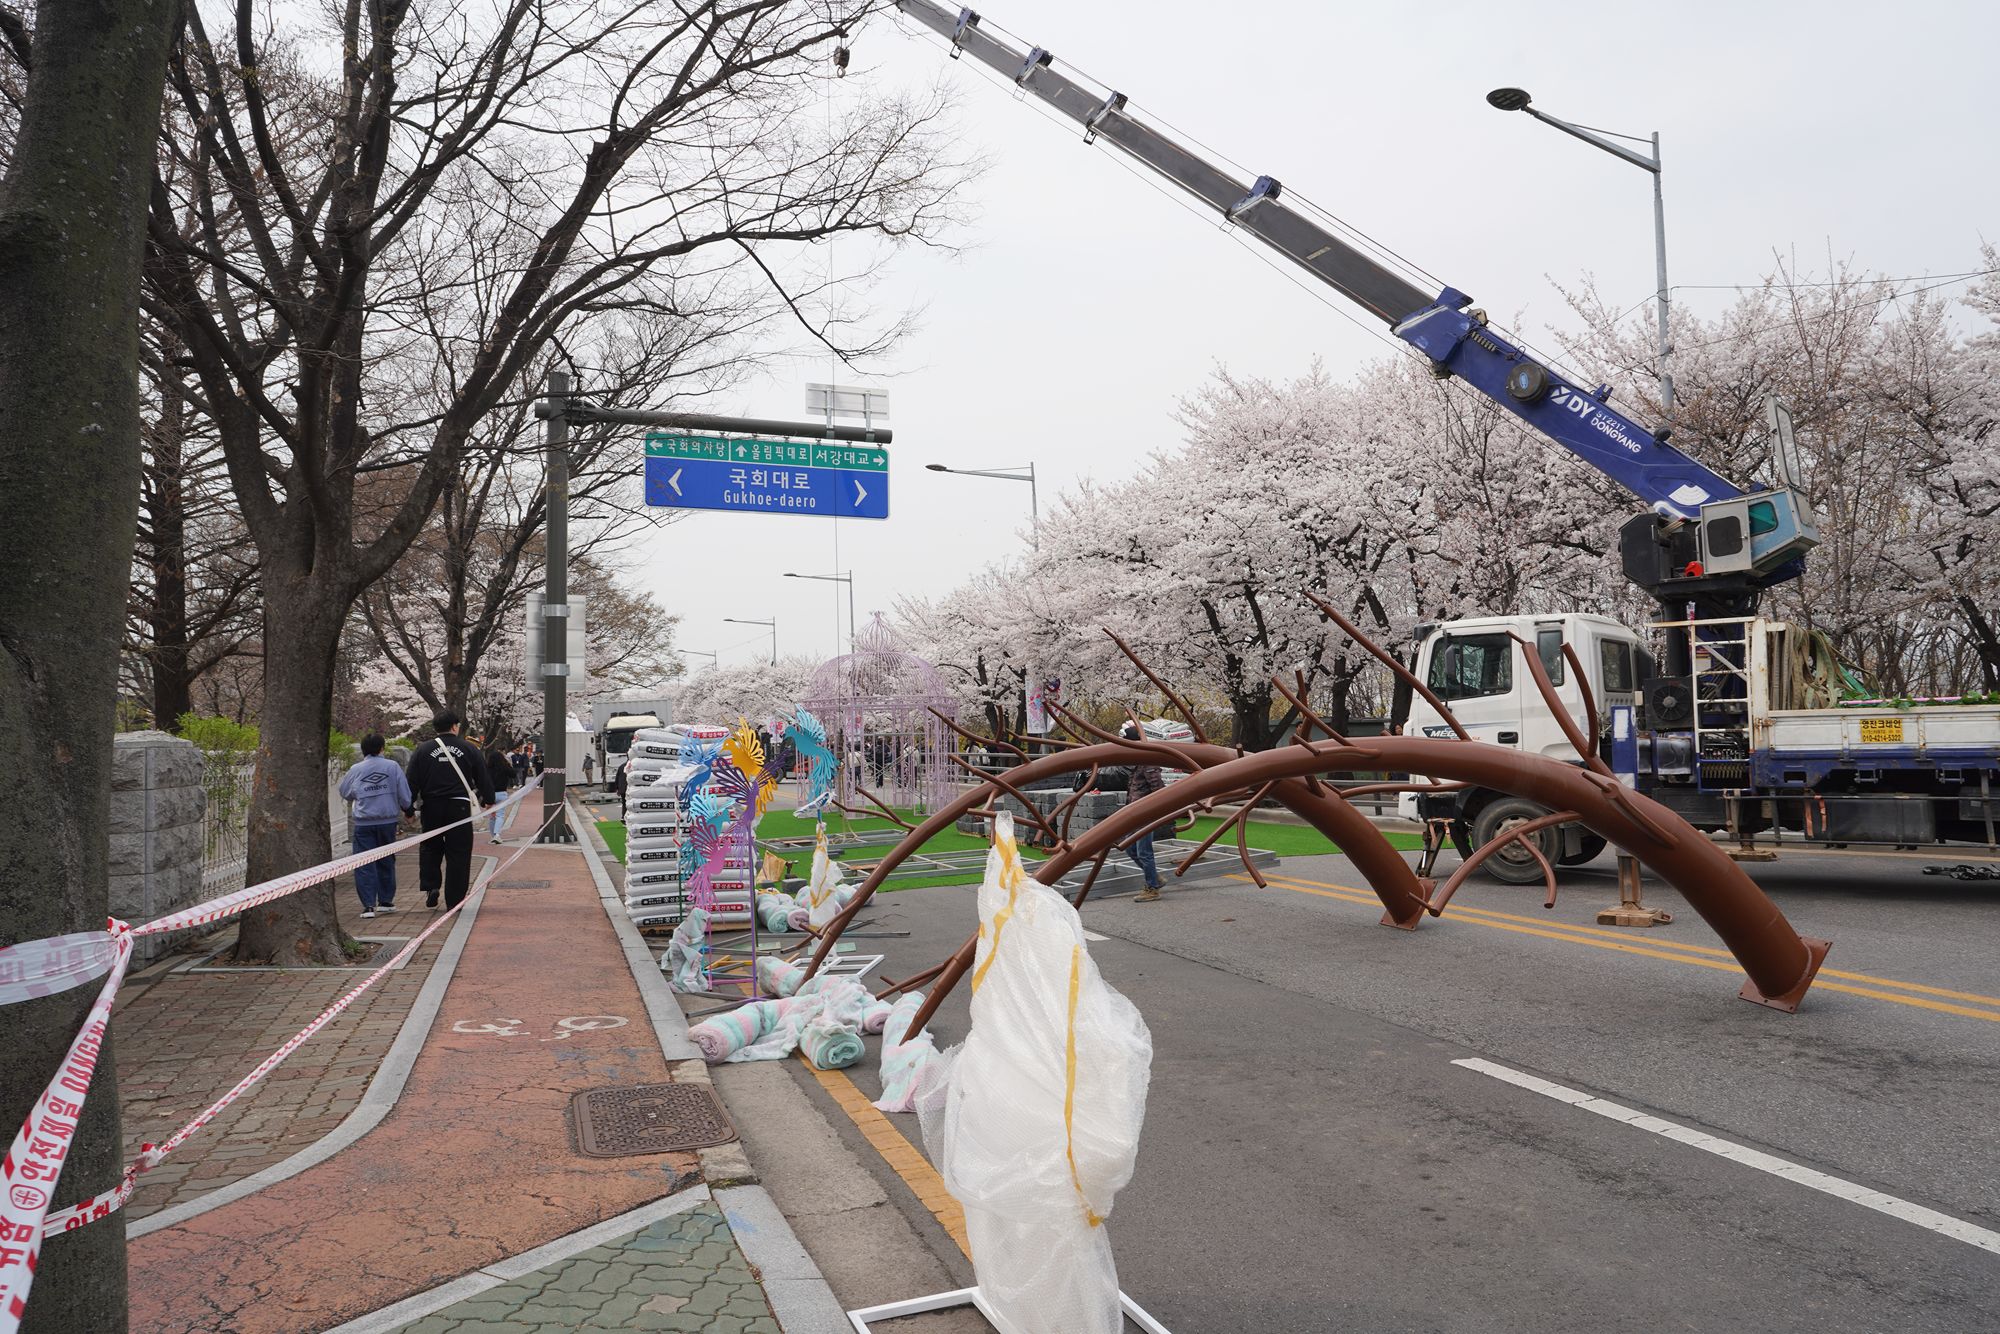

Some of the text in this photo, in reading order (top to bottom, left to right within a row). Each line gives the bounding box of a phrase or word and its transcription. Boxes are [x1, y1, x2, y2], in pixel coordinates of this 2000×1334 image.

[1566, 395, 1595, 418] DY
[1590, 416, 1642, 453] DONGYANG
[666, 438, 726, 457] 국회의사당
[751, 444, 808, 461] 올림픽대로
[815, 450, 870, 465] 서강대교
[728, 468, 811, 490] 국회대로
[723, 490, 816, 508] Gukhoe-daero
[20, 1095, 82, 1182] 안전제일
